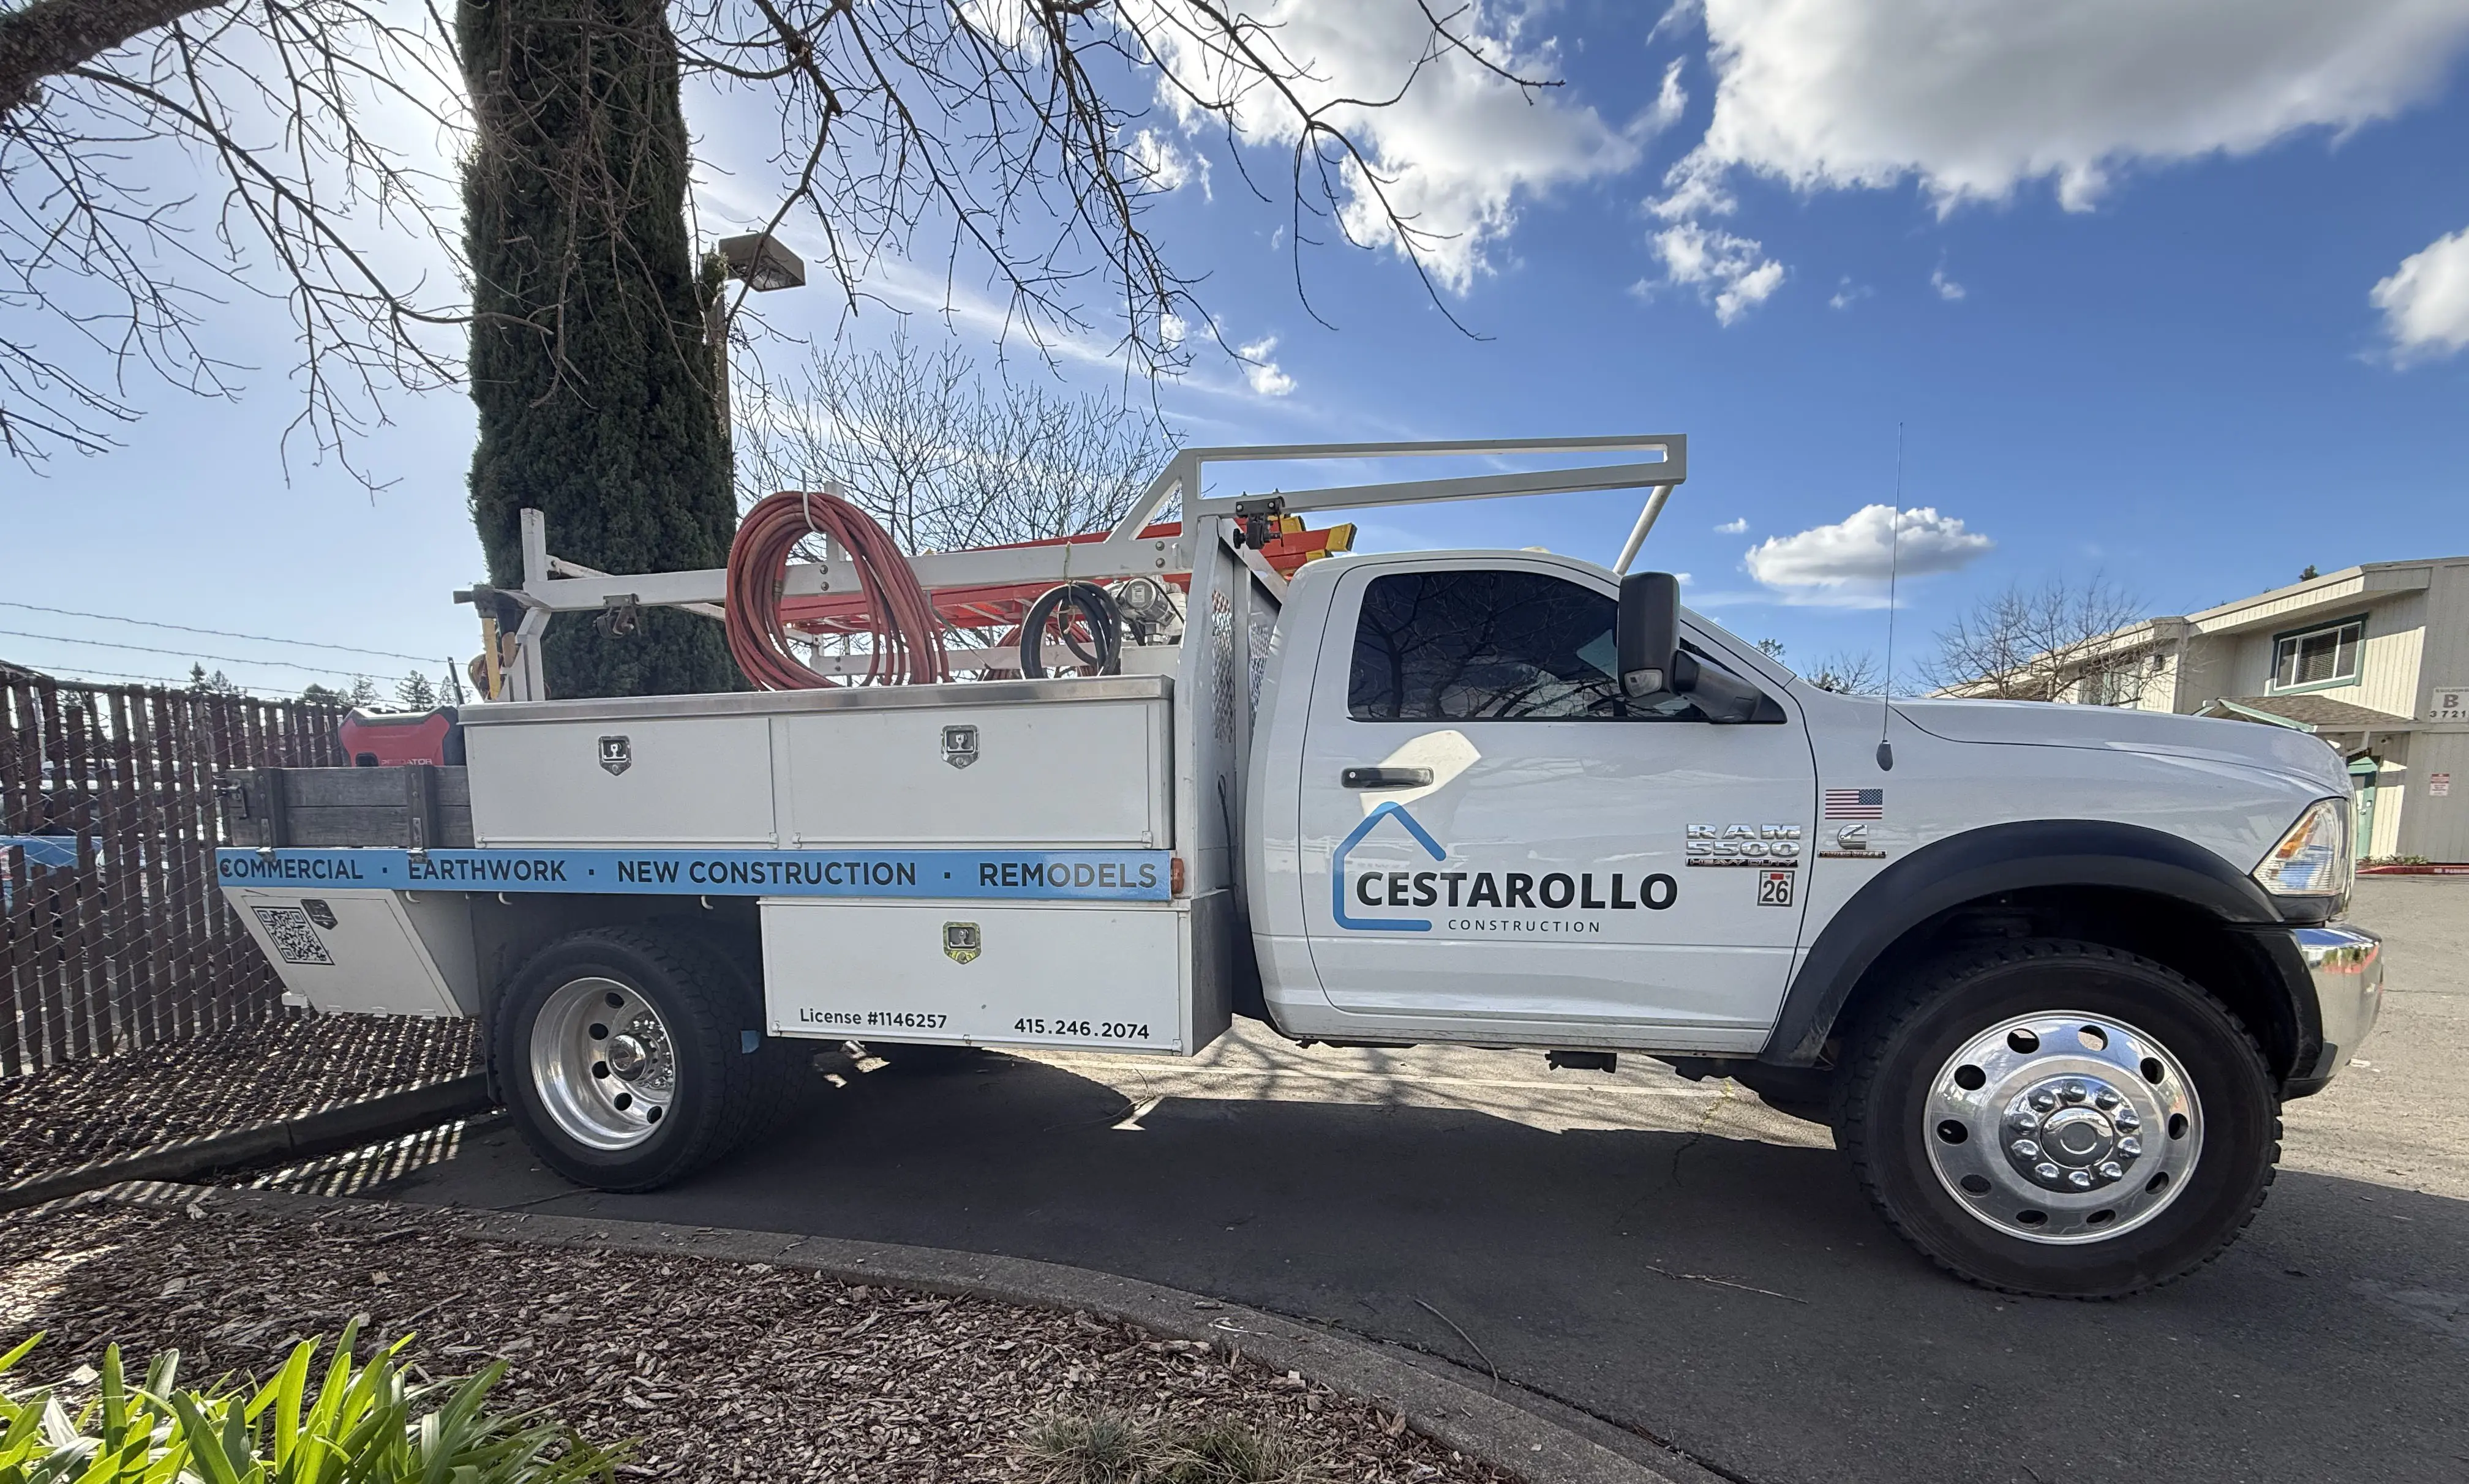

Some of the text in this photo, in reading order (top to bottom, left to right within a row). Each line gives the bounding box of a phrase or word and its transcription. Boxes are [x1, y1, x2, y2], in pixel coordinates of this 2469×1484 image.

[2443, 694, 2459, 708] B
[1687, 823, 1801, 839] RAM
[1686, 841, 1800, 857] 5500
[1748, 858, 1797, 867] DUTY
[219, 858, 1157, 888] COMMERCIAL EARTHWORK NEW CONSTRUCTION REMODELS
[1356, 871, 1678, 910] CESTAROLLO
[1761, 880, 1789, 903] 26
[1448, 919, 1600, 932] CONSTRUCTION
[800, 1008, 947, 1029] License #1146257
[1013, 1017, 1150, 1040] 415.246.2074
